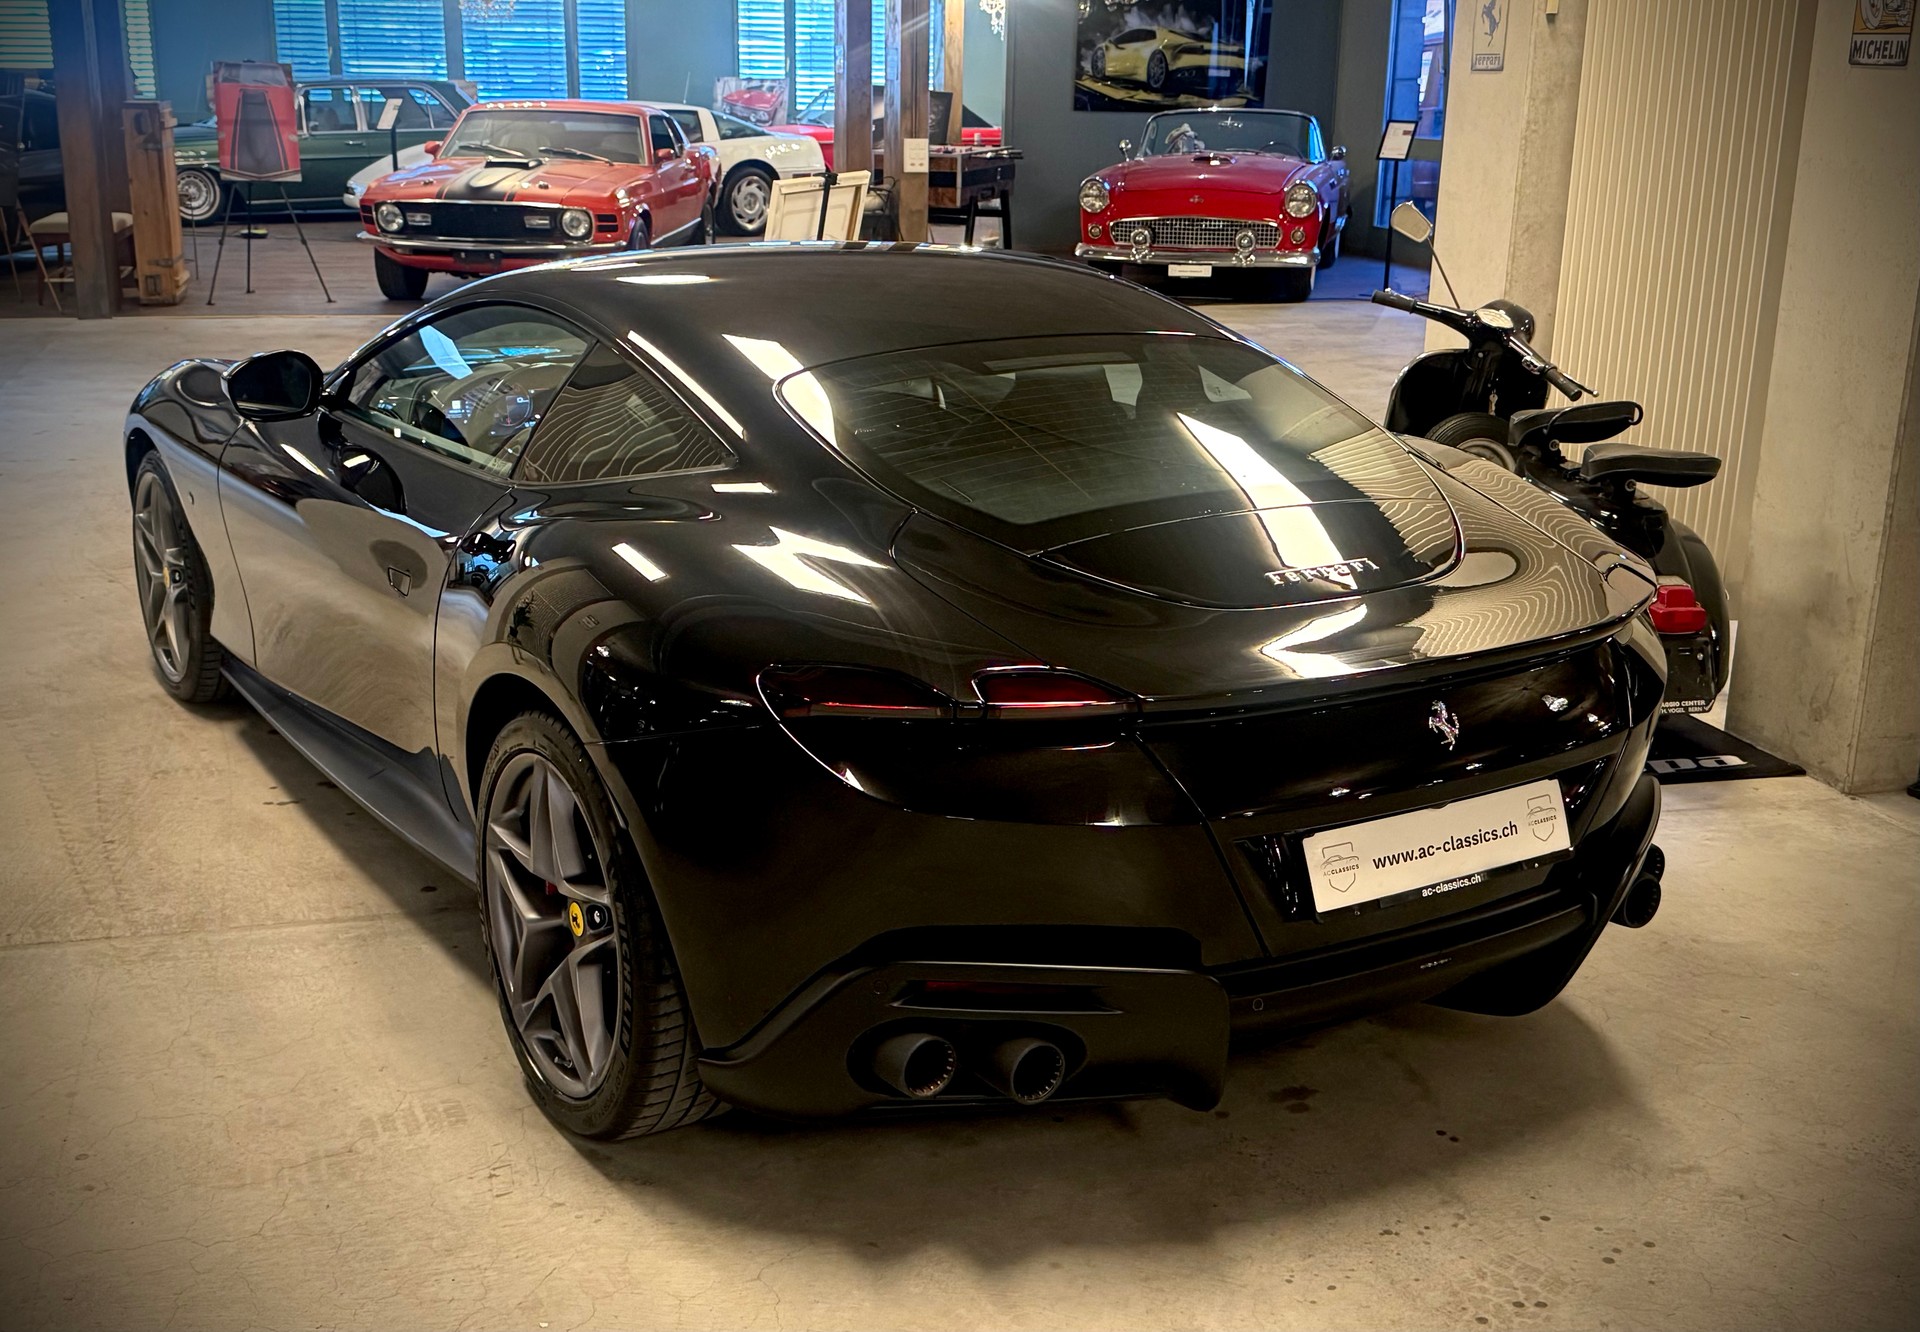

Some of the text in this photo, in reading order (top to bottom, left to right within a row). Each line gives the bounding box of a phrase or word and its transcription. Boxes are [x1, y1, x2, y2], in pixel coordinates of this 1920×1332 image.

[1852, 39, 1909, 60] MICHELIN
[1264, 557, 1380, 587] Ferrari
[1372, 820, 1519, 870] www.ac-classics.ch
[1421, 873, 1482, 898] ac-classics.ch
[614, 902, 632, 1052] MICHELIN
